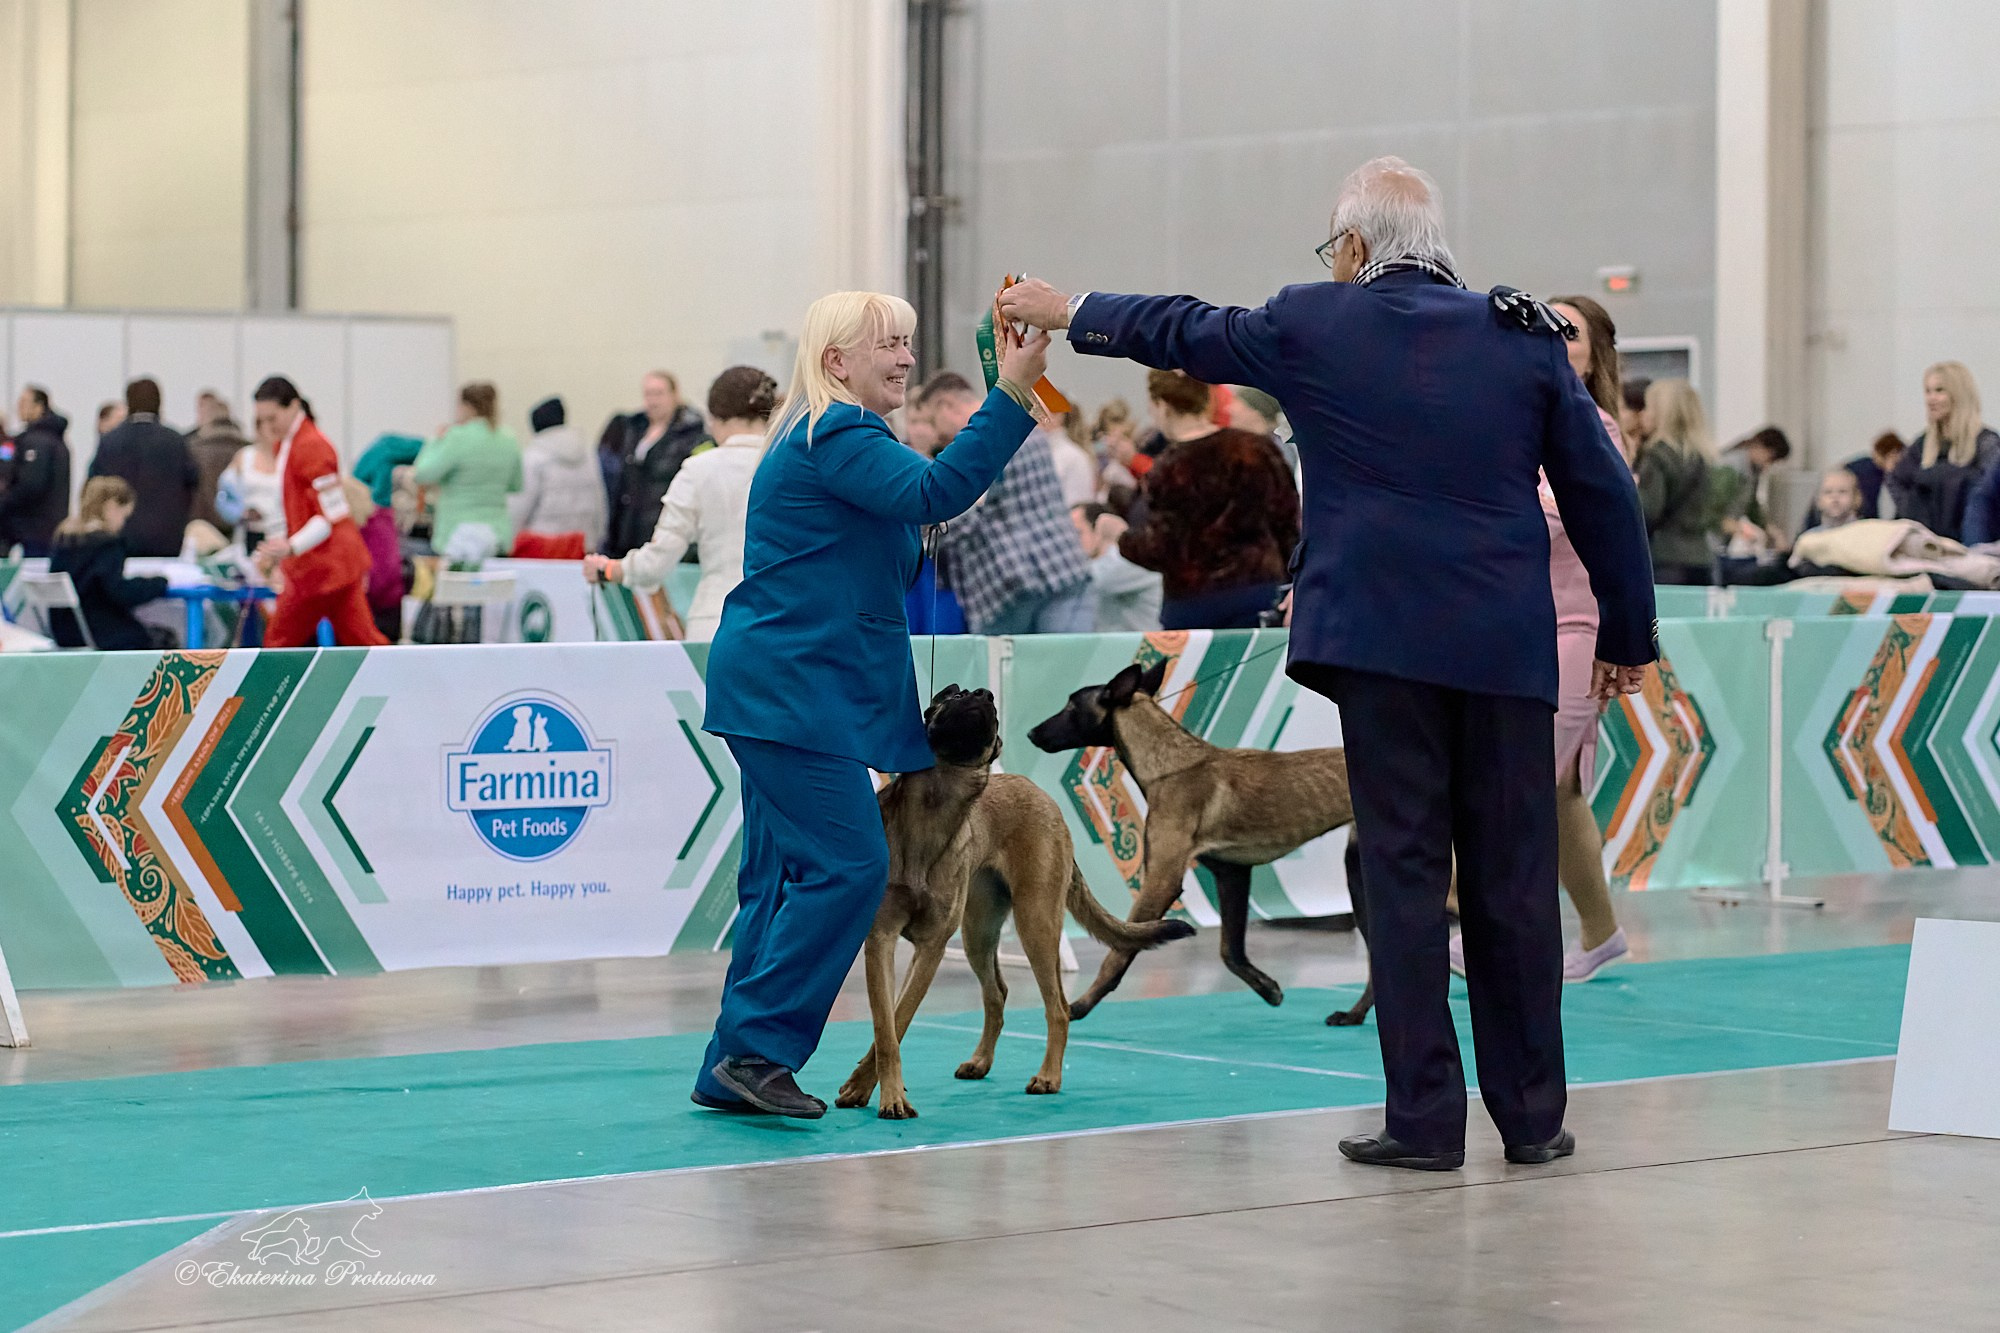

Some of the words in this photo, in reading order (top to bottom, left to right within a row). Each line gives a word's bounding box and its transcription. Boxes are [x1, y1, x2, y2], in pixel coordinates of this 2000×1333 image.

[460, 760, 599, 802] Farmina
[492, 818, 517, 838] Pet
[522, 816, 568, 837] Foods
[447, 884, 493, 904] Happy
[498, 883, 526, 902] pet.
[531, 880, 576, 899] Happy
[581, 881, 611, 899] you.
